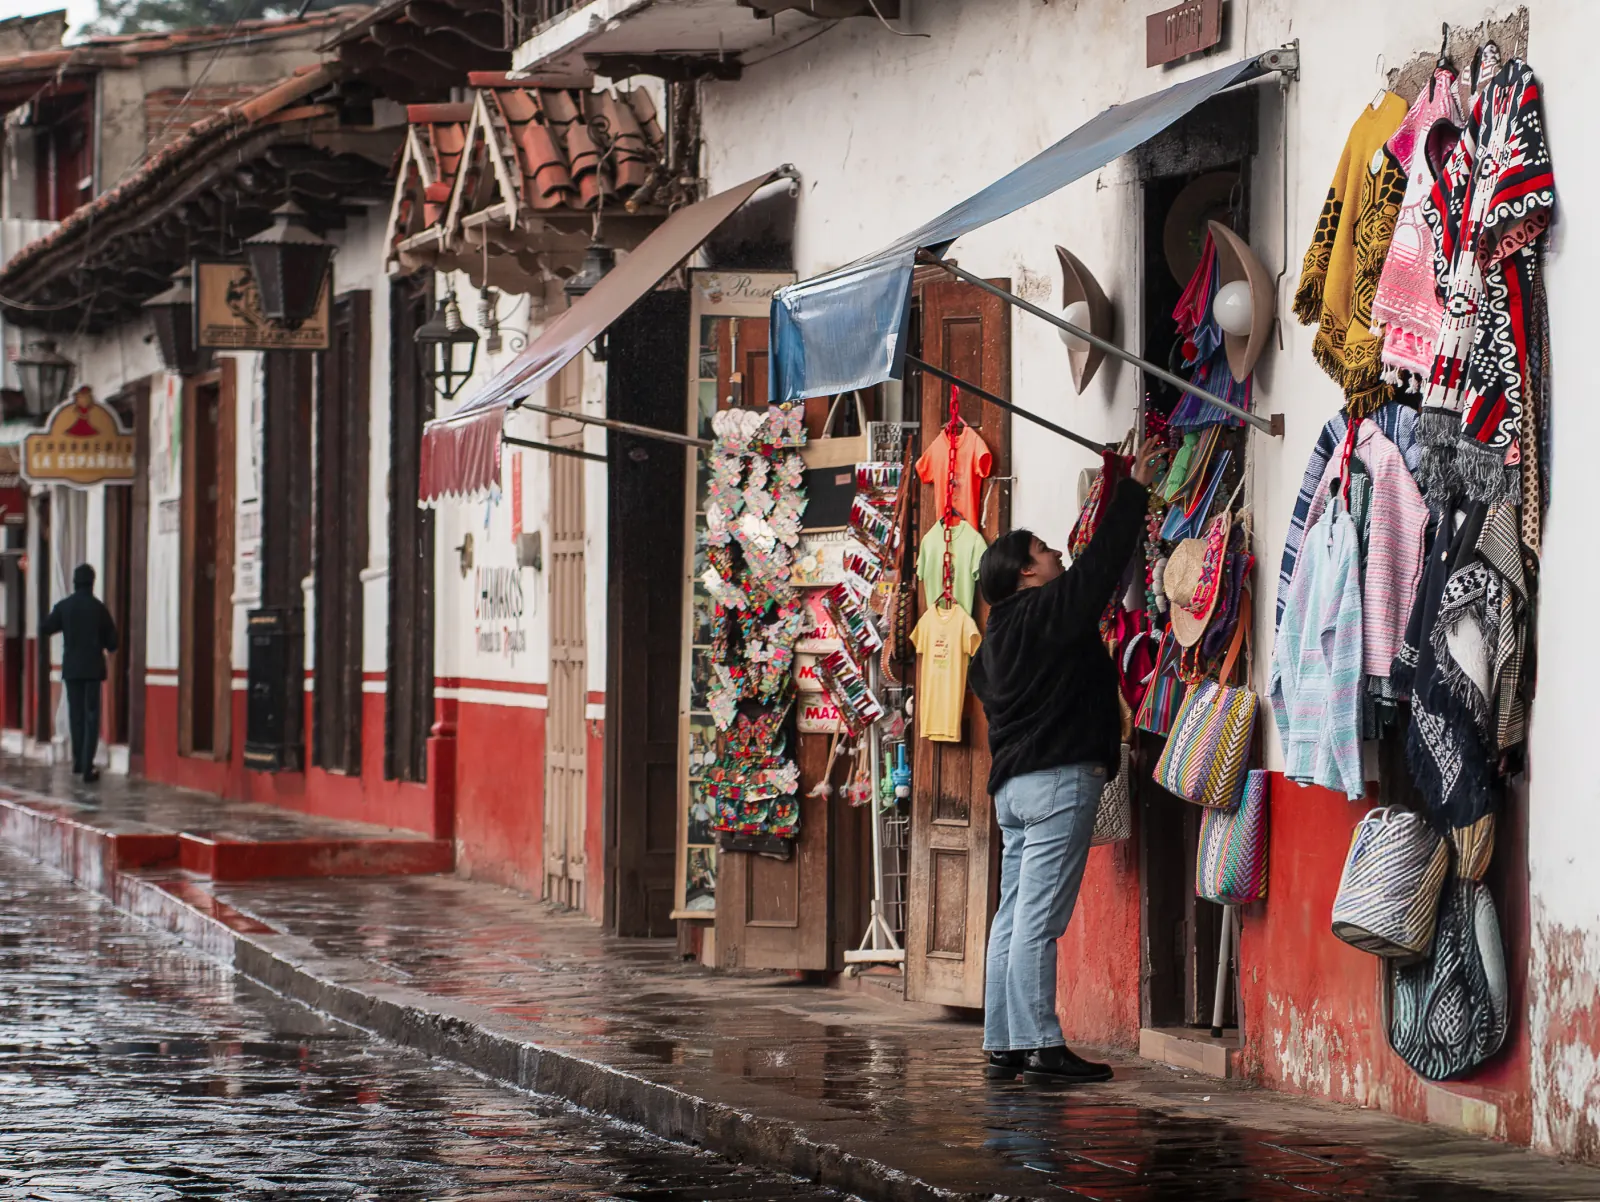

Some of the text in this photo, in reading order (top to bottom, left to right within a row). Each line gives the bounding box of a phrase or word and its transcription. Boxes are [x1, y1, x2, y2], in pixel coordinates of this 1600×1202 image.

[726, 275, 782, 298] Rosi
[32, 455, 52, 469] LA
[827, 582, 877, 658] MAZAMITLA
[823, 650, 880, 726] MAZAMITLA
